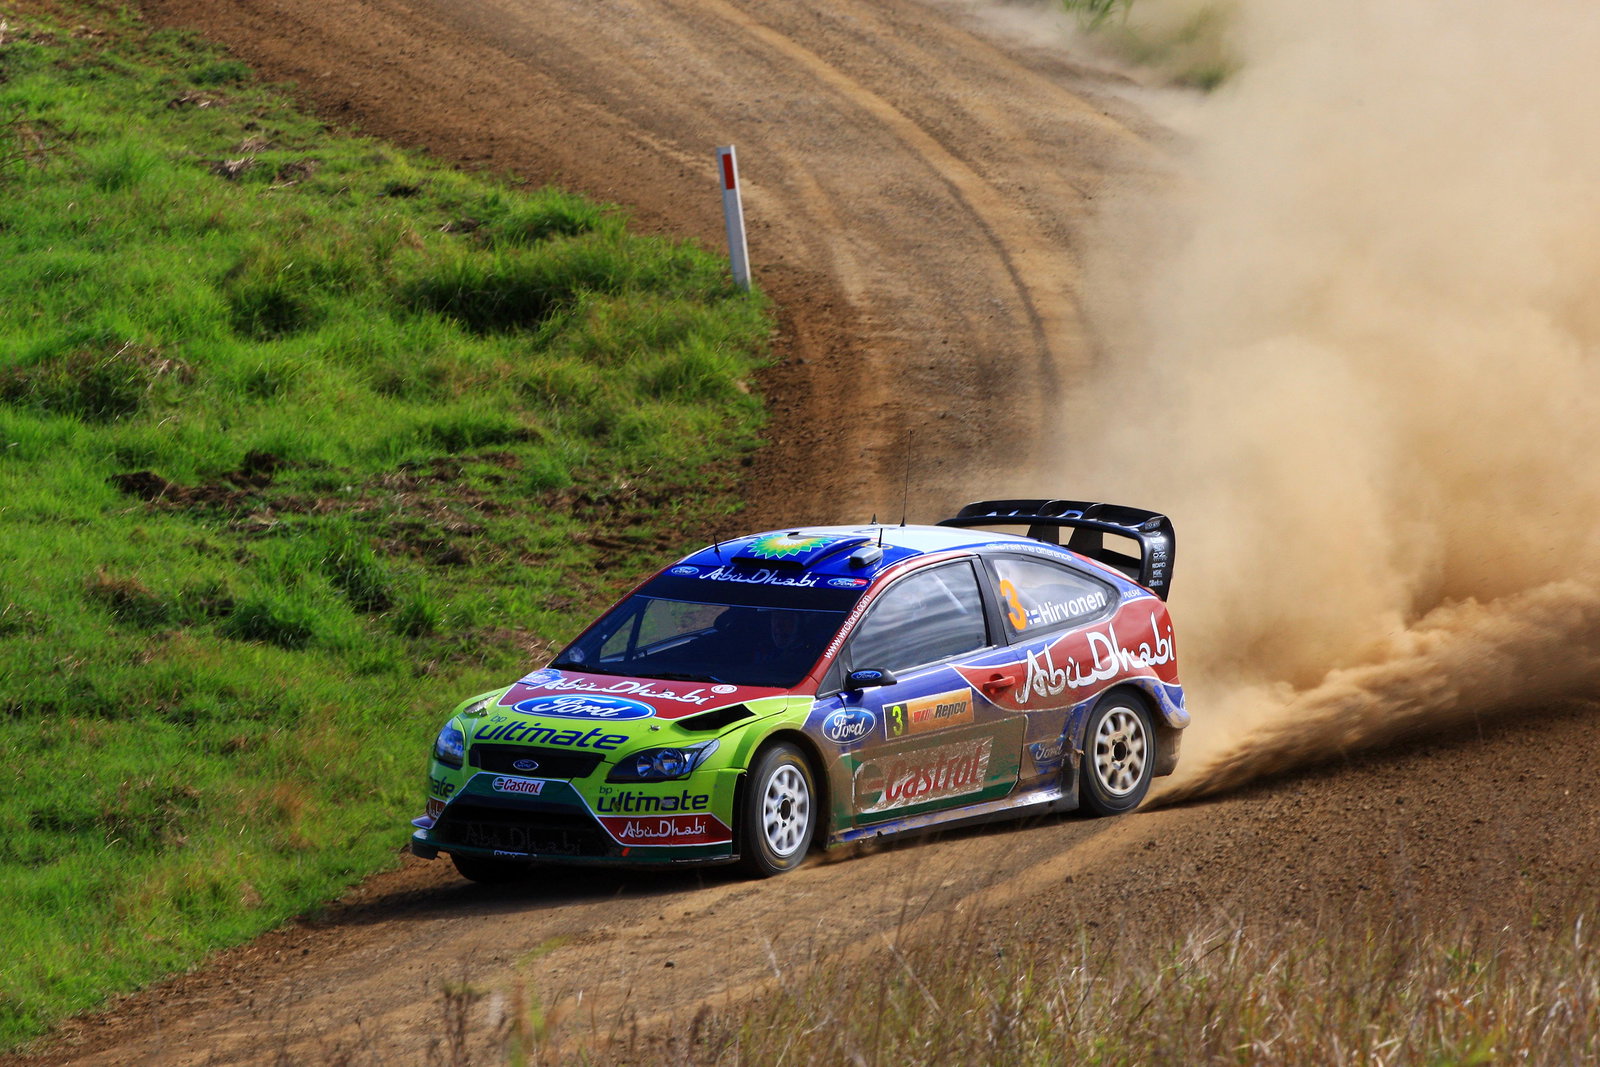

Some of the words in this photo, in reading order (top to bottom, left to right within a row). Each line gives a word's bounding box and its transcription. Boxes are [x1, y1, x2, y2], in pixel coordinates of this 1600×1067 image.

[999, 578, 1027, 631] 3
[1037, 590, 1107, 625] Hirvonen
[855, 671, 877, 680] Ford
[531, 695, 633, 718] Ford
[934, 701, 968, 719] Repco
[831, 713, 866, 739] Ford
[891, 705, 904, 736] 3
[1035, 742, 1063, 760] Ford
[885, 744, 983, 802] Castrol
[504, 779, 542, 794] Castrol
[600, 786, 612, 794] bp
